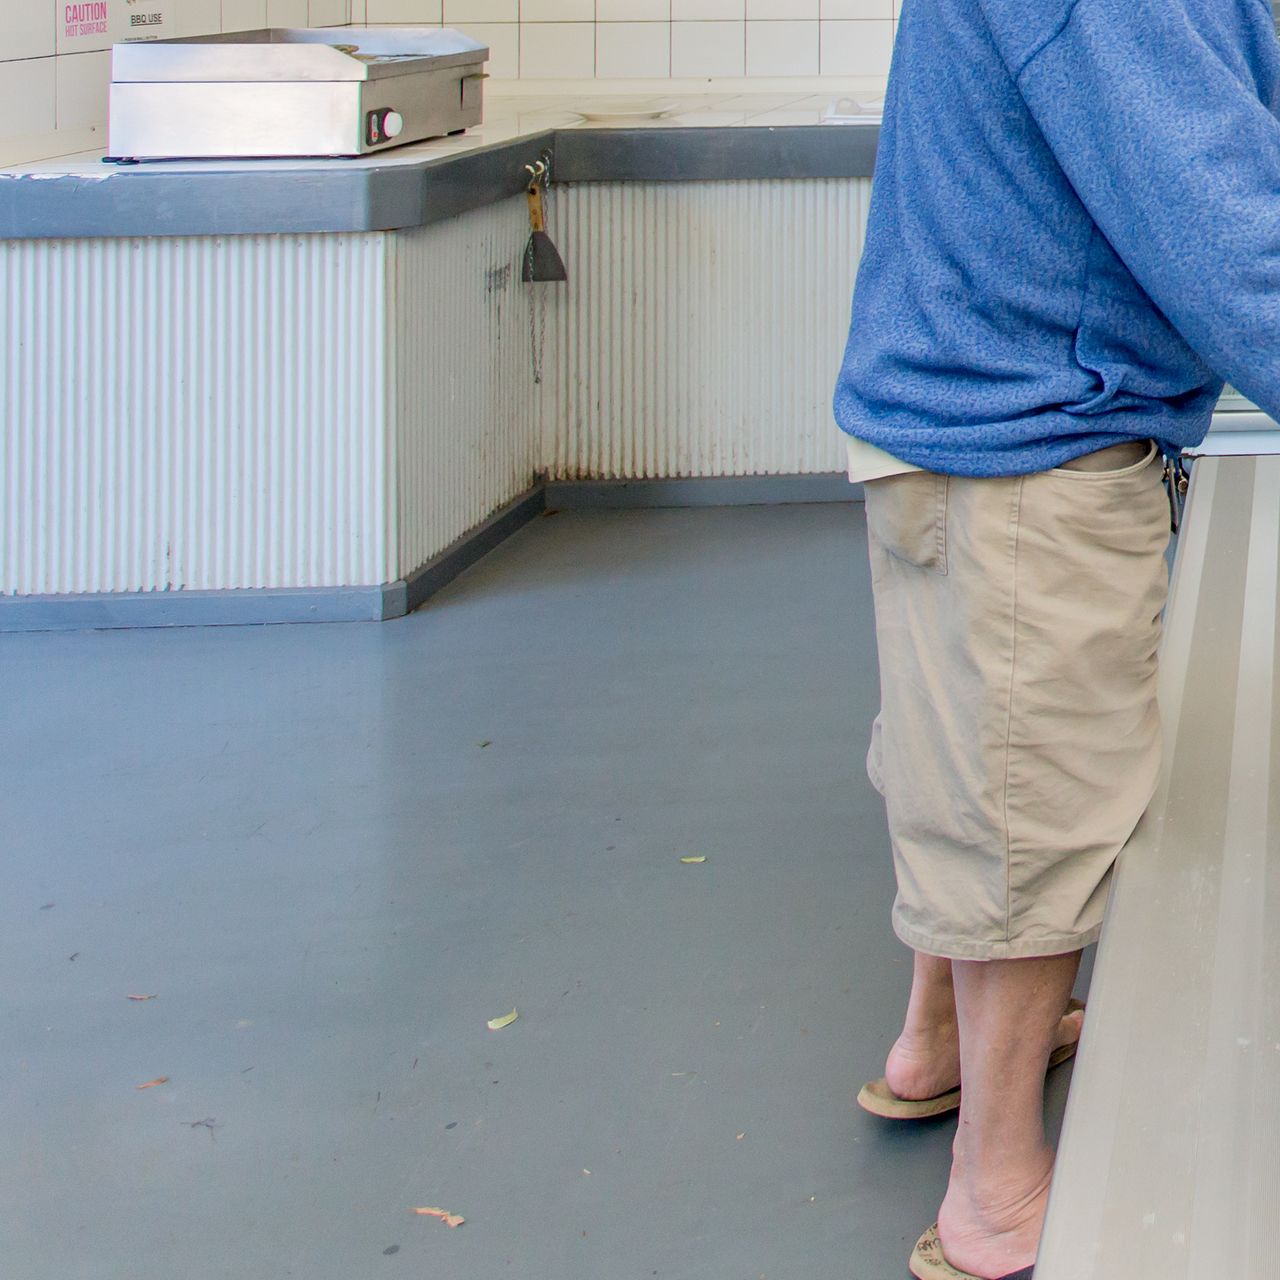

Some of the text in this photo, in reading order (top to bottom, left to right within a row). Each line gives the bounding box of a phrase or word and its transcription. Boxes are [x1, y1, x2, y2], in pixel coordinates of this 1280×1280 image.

[65, 1, 107, 24] CAUTION
[130, 13, 162, 24] BBQ USE
[65, 21, 108, 37] HOT SURFACE
